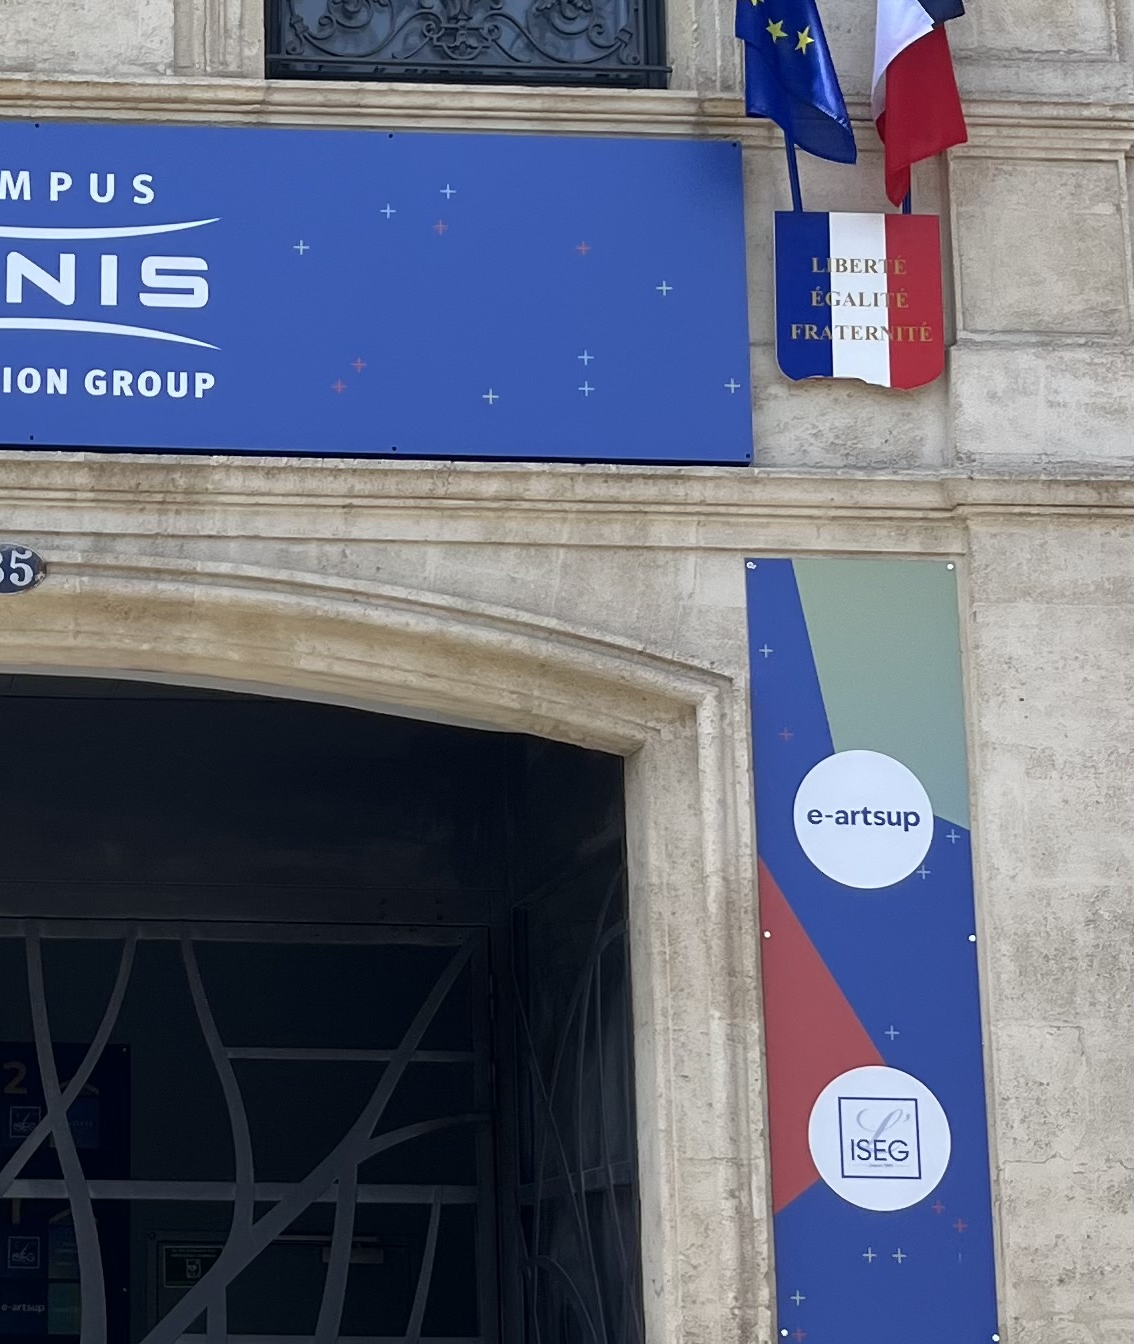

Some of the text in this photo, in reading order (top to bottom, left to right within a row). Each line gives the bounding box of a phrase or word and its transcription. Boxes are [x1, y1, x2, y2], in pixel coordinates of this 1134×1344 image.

[811, 256, 907, 275] LIBERTÉ
[809, 286, 909, 309] ÉGALITÉ
[790, 321, 934, 342] FRATERNITÉ
[84, 368, 216, 399] GROUP
[806, 806, 921, 832] e-artsup
[2, 1060, 28, 1095] 2
[850, 1138, 910, 1162] ISEG
[1, 1302, 46, 1313] e-artsup
